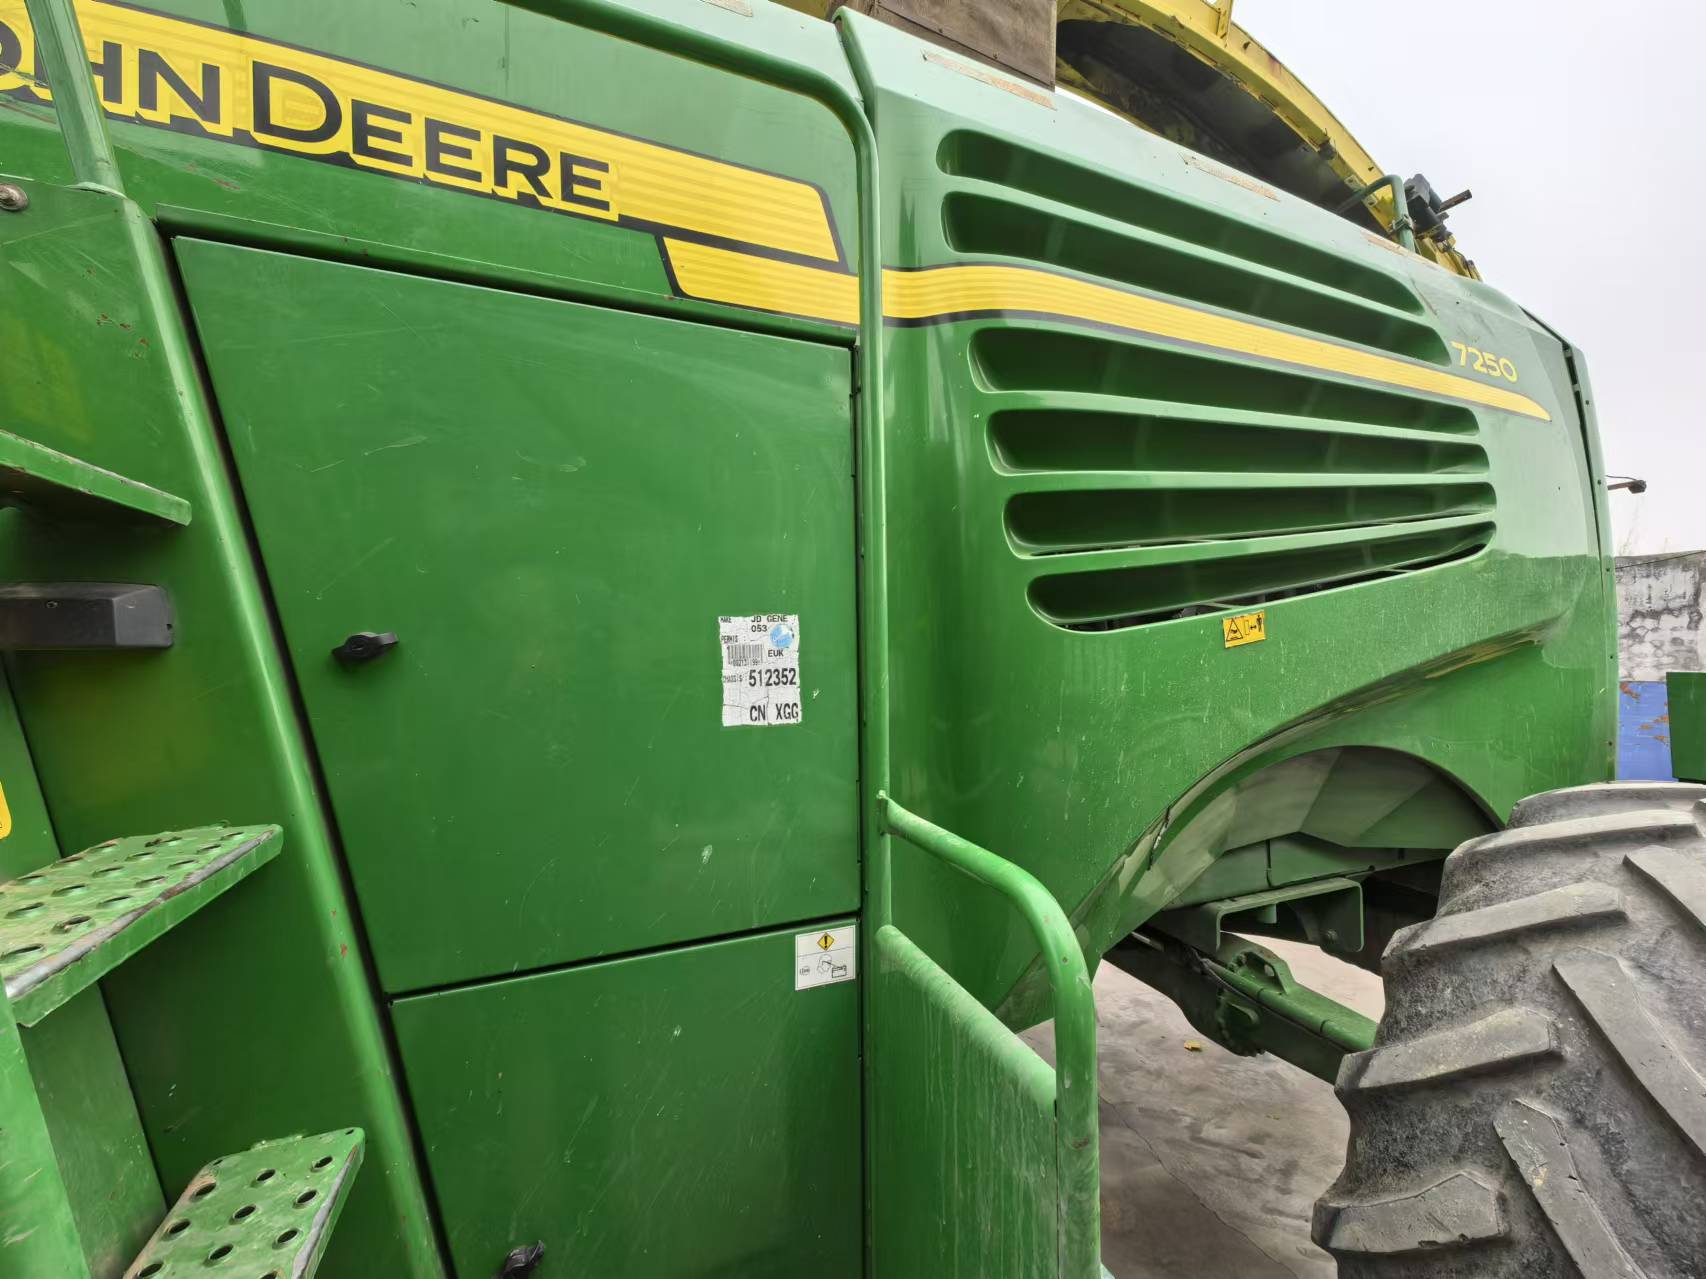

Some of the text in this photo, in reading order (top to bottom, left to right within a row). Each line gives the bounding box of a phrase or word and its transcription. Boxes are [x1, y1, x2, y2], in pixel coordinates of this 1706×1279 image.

[252, 60, 611, 212] DEERE
[1451, 341, 1518, 382] 7250
[751, 615, 762, 623] JD
[751, 624, 768, 633] 053
[768, 649, 784, 657] EUK
[749, 668, 796, 687] 512352
[750, 703, 798, 721] CN XGG
